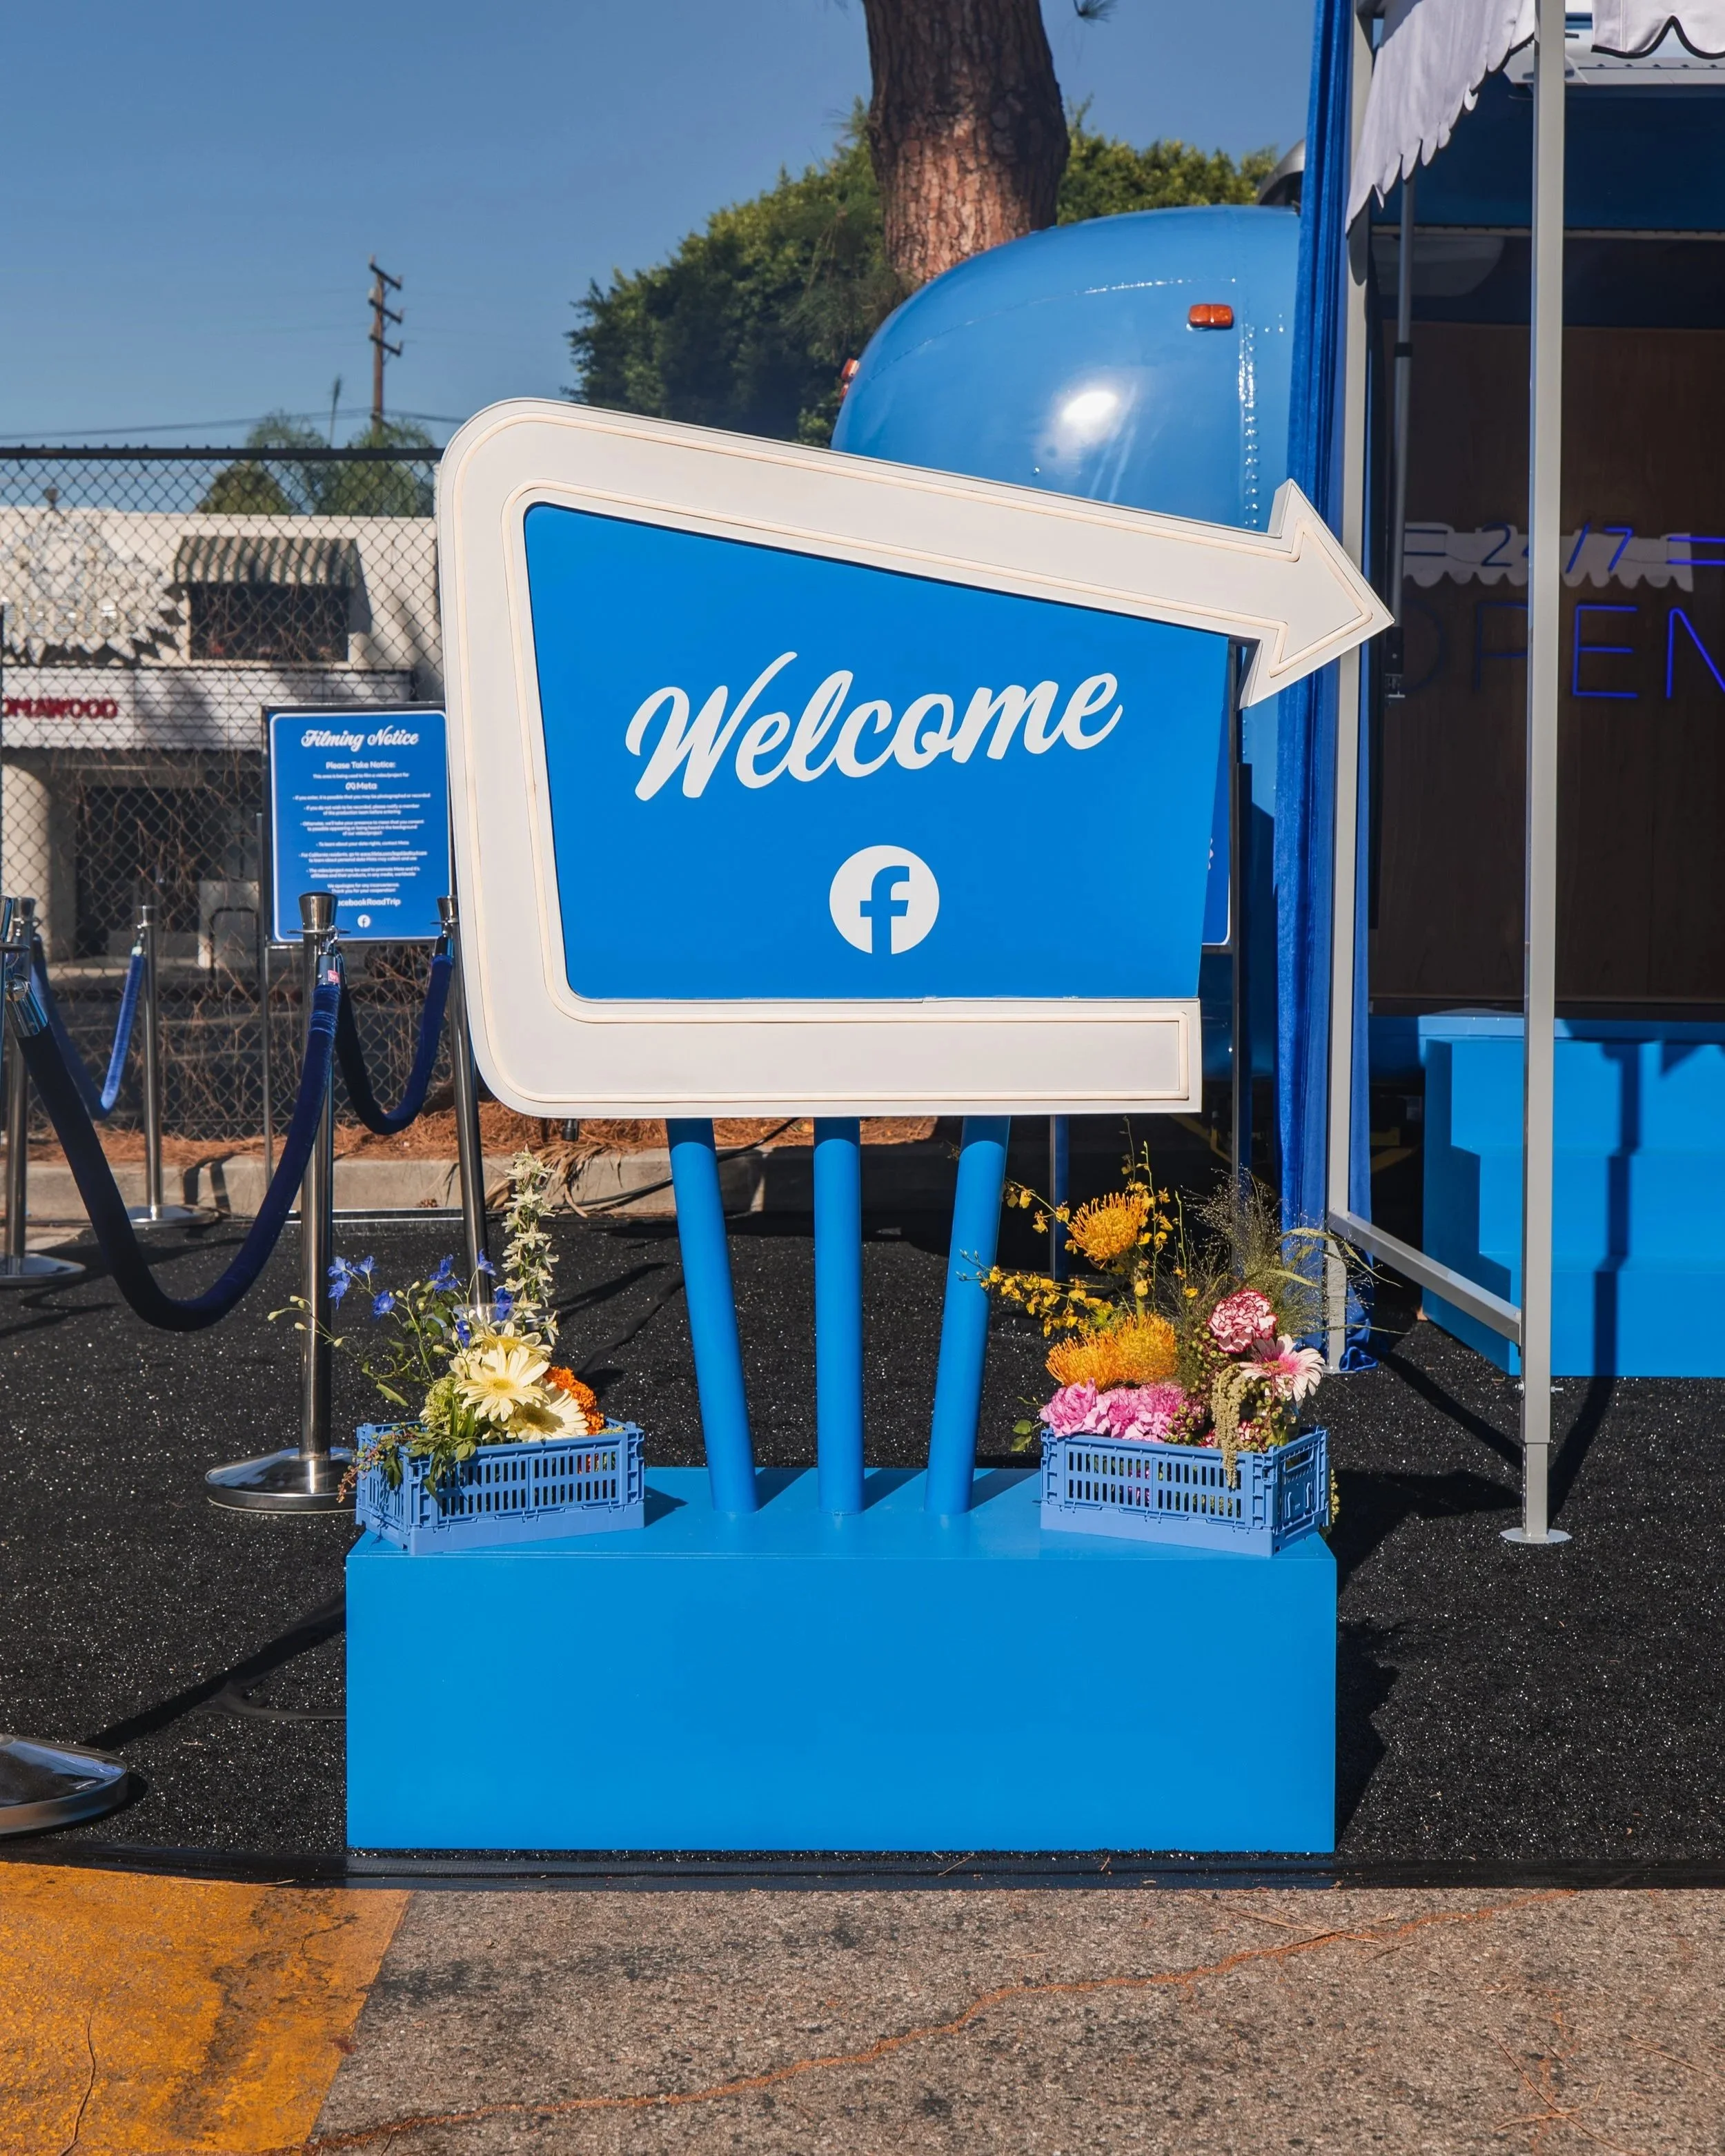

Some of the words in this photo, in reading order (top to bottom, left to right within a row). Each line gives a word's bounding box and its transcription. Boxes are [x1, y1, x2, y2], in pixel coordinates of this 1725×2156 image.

[1481, 522, 1633, 575] 2/7
[301, 729, 365, 752] Filming
[367, 725, 420, 746] Notice
[625, 651, 1123, 801] Welcome
[326, 761, 351, 770] Please
[351, 761, 369, 769] Take
[337, 898, 402, 908] cebookRoadTrip
